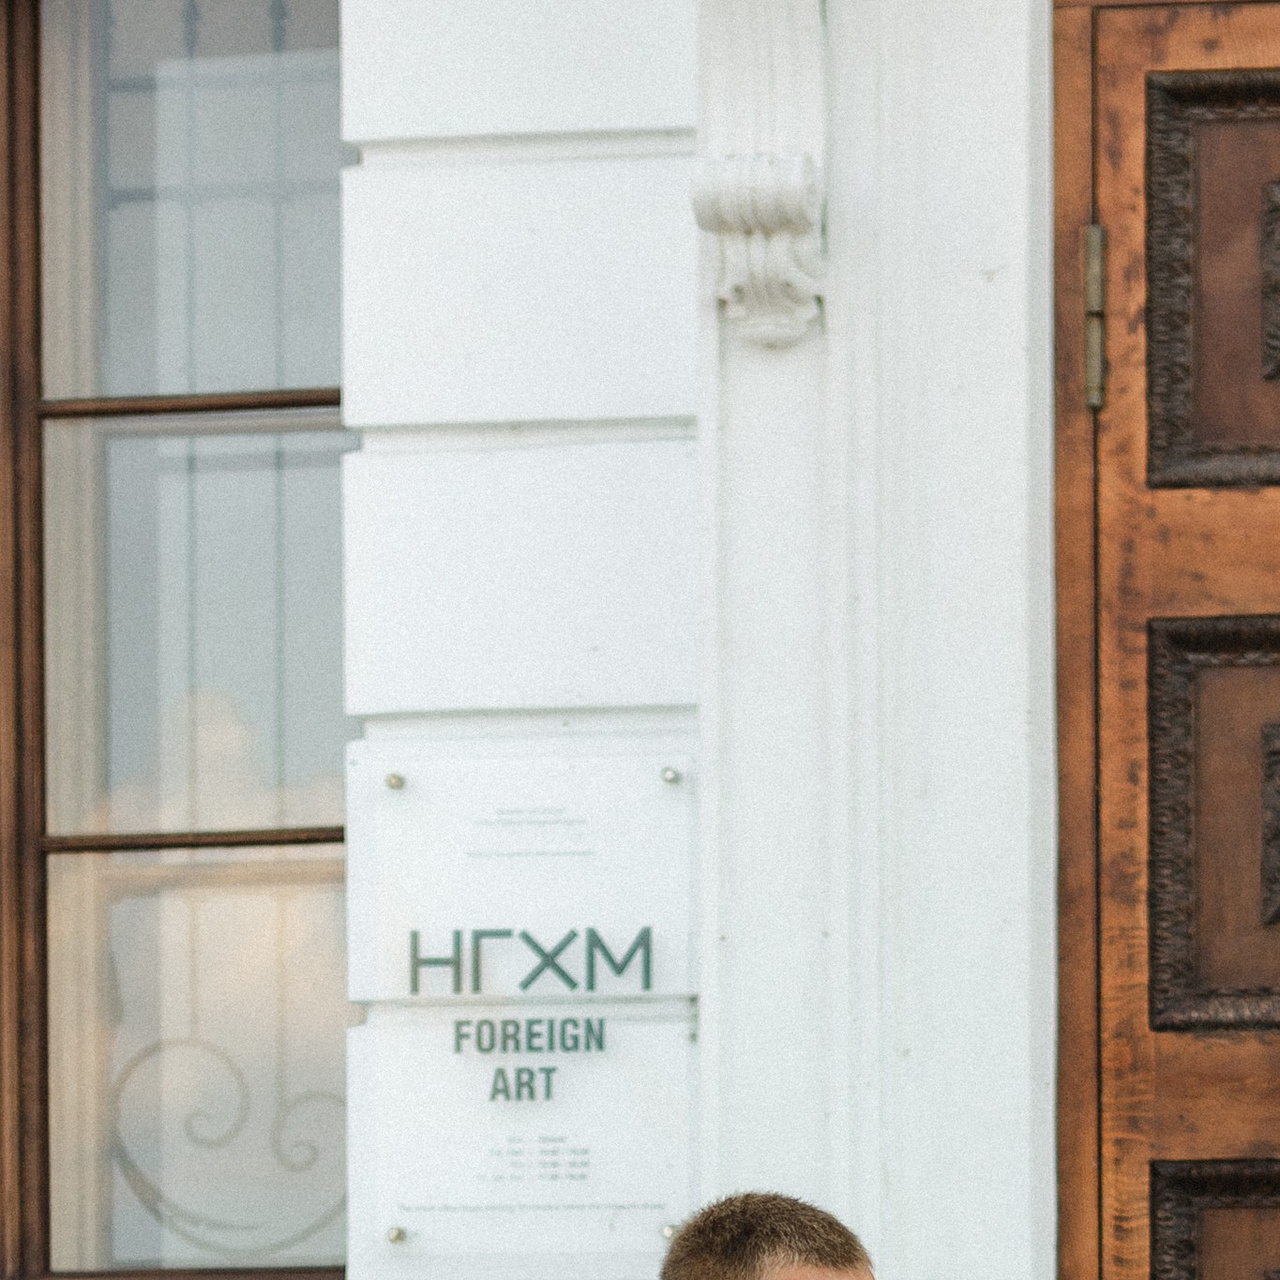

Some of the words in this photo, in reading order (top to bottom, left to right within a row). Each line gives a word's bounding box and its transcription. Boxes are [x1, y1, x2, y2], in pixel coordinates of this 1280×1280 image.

[410, 926, 653, 994] НГХМ
[453, 1018, 604, 1054] FOREIGN
[489, 1066, 557, 1102] ART
